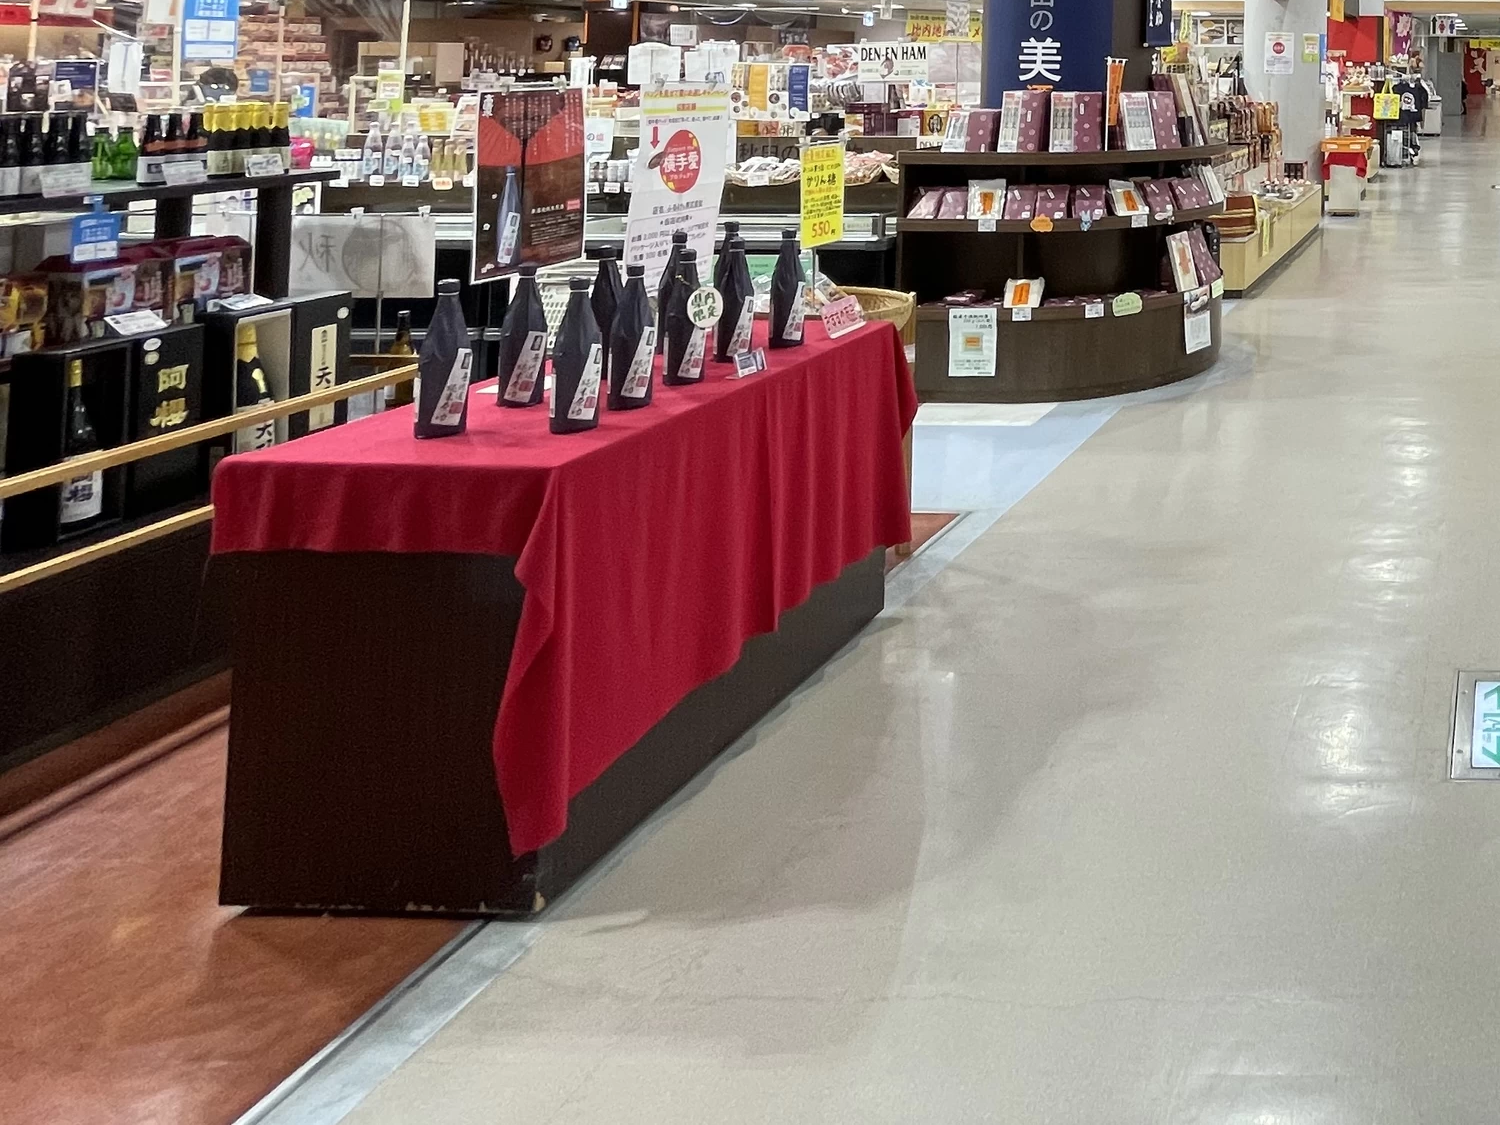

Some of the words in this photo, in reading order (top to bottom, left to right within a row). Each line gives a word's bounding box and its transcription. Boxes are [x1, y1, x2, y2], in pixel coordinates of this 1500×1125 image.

[861, 45, 898, 61] DEN-EN
[901, 45, 927, 60] HAM
[663, 151, 698, 173] 横手愛
[812, 220, 830, 238] 550
[693, 306, 719, 323] 限定
